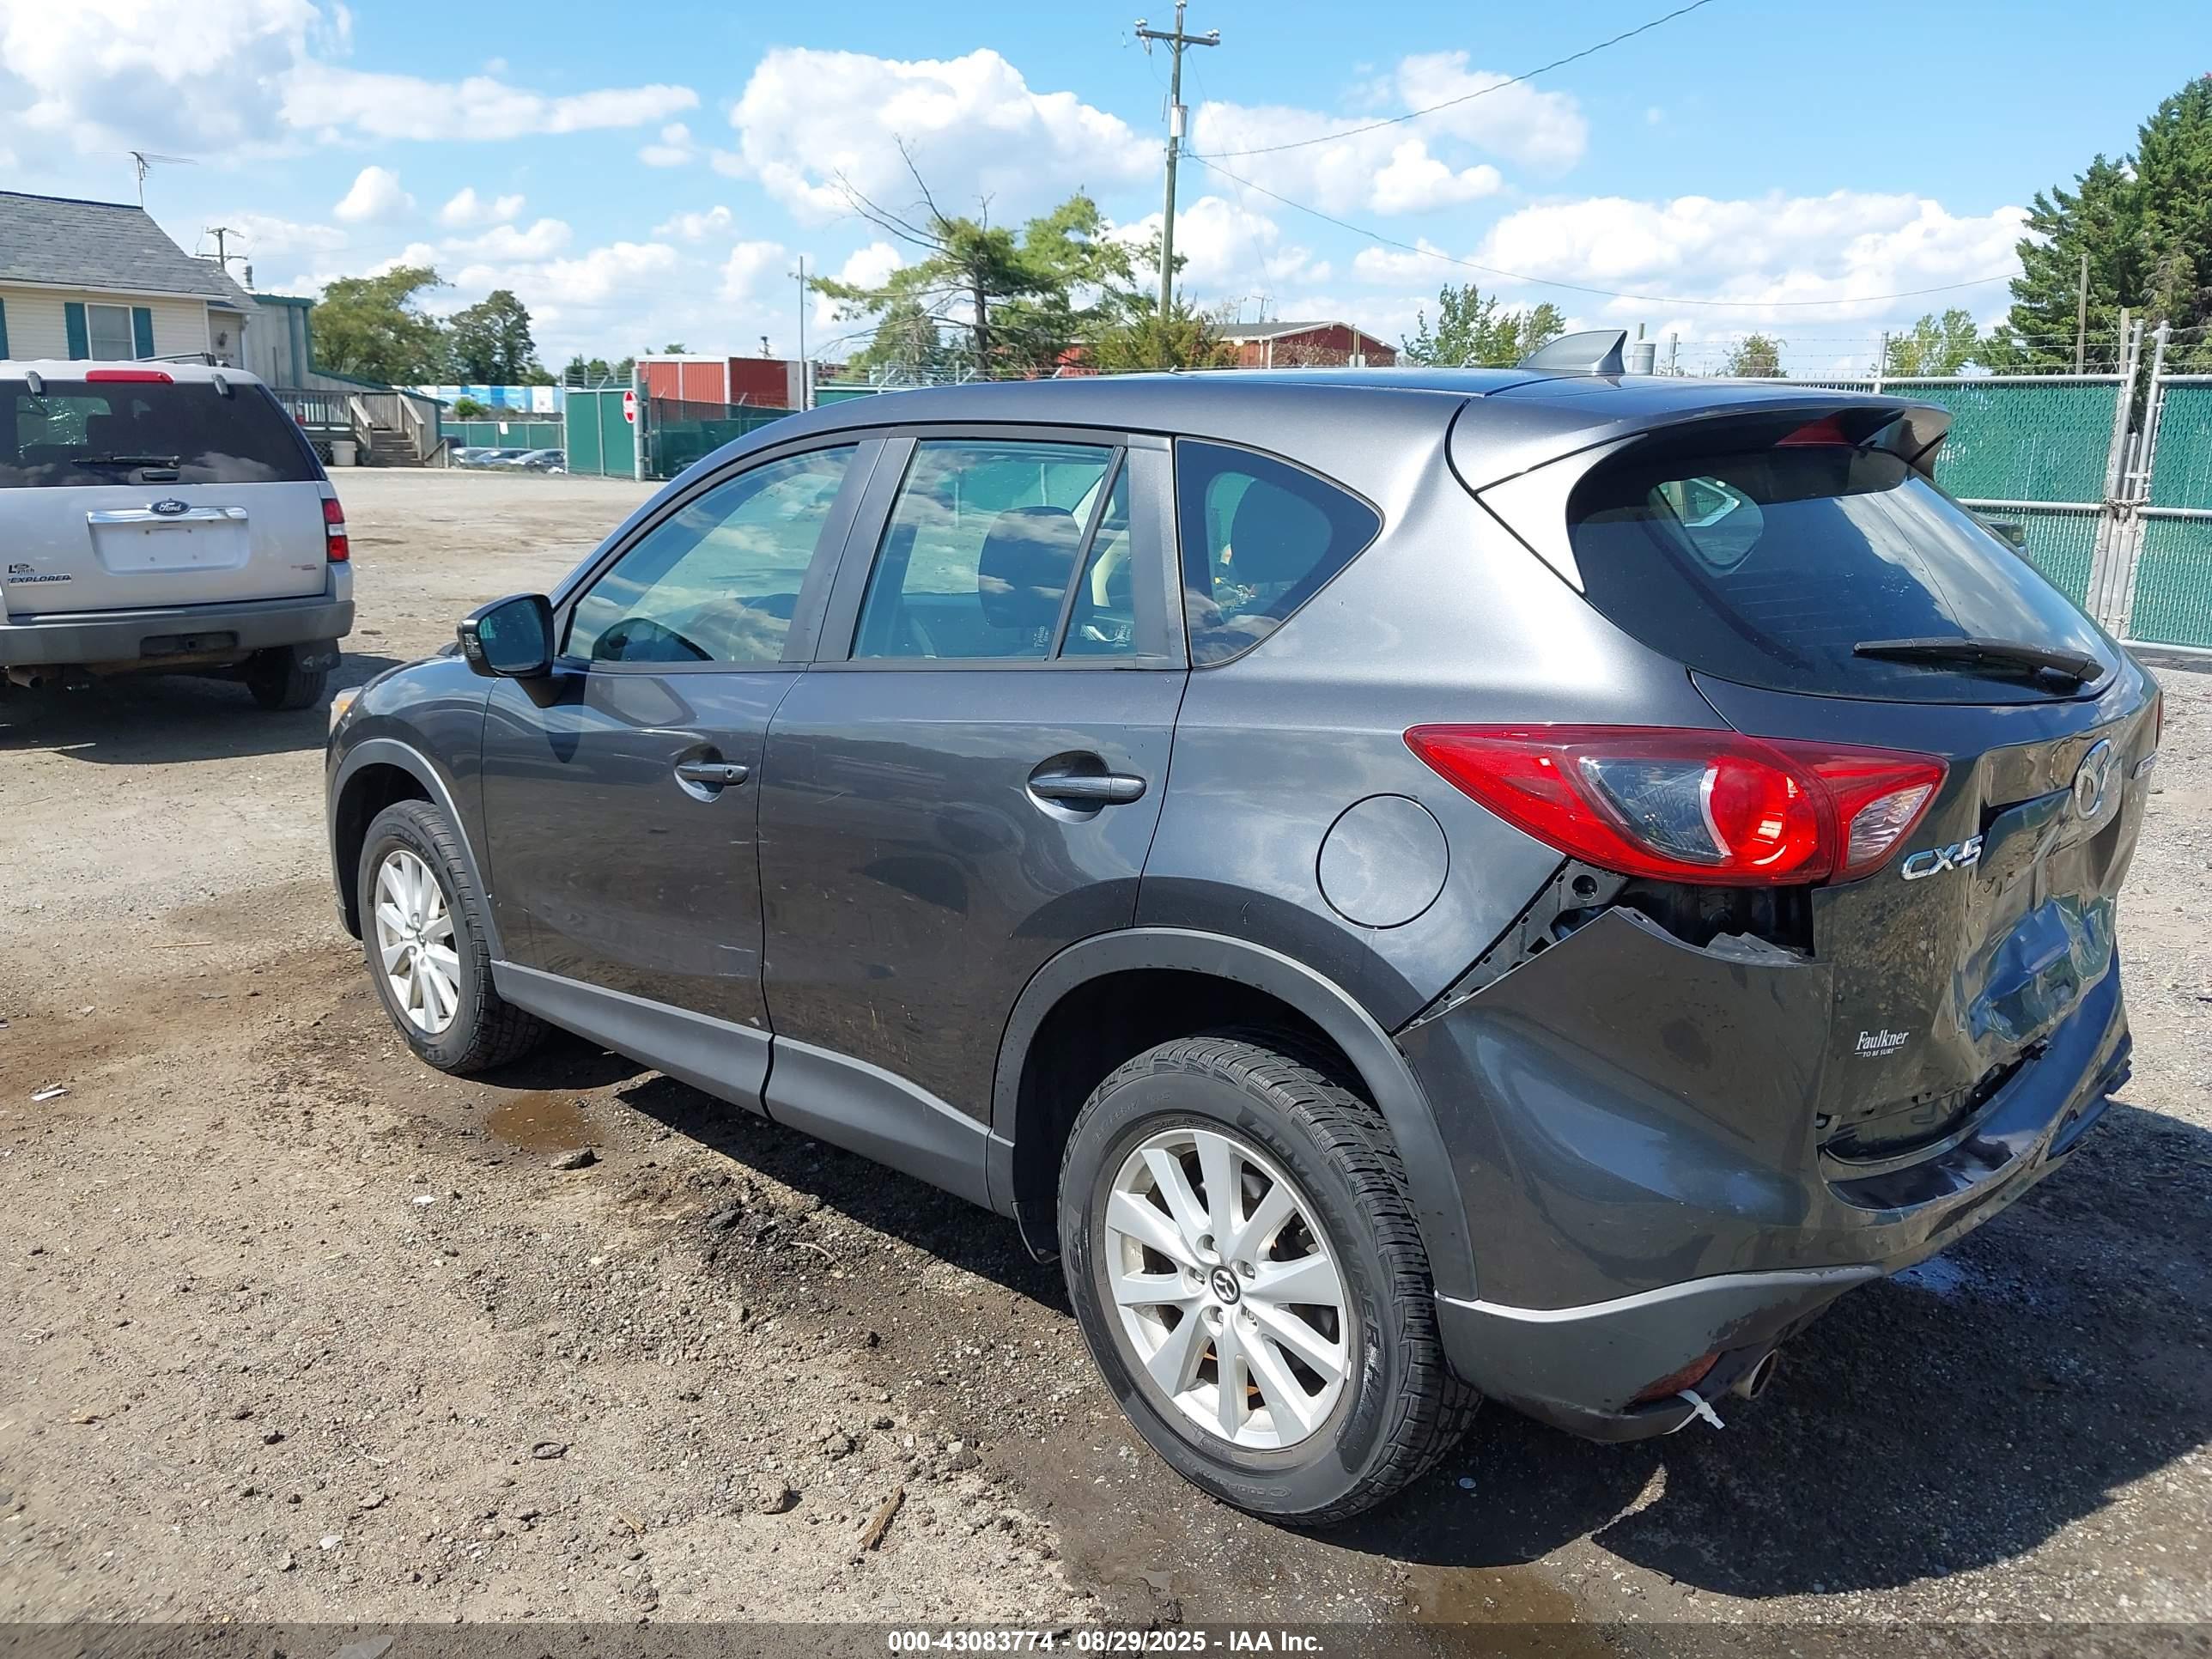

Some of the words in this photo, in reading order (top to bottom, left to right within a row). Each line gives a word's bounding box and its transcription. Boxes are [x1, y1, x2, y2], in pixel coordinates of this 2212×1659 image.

[159, 502, 182, 512] Ford
[9, 574, 72, 584] EXPLORER
[1901, 835, 1984, 880] CX-5
[1855, 1029, 1910, 1051] Faulkner
[1880, 1048, 1894, 1056] SURE
